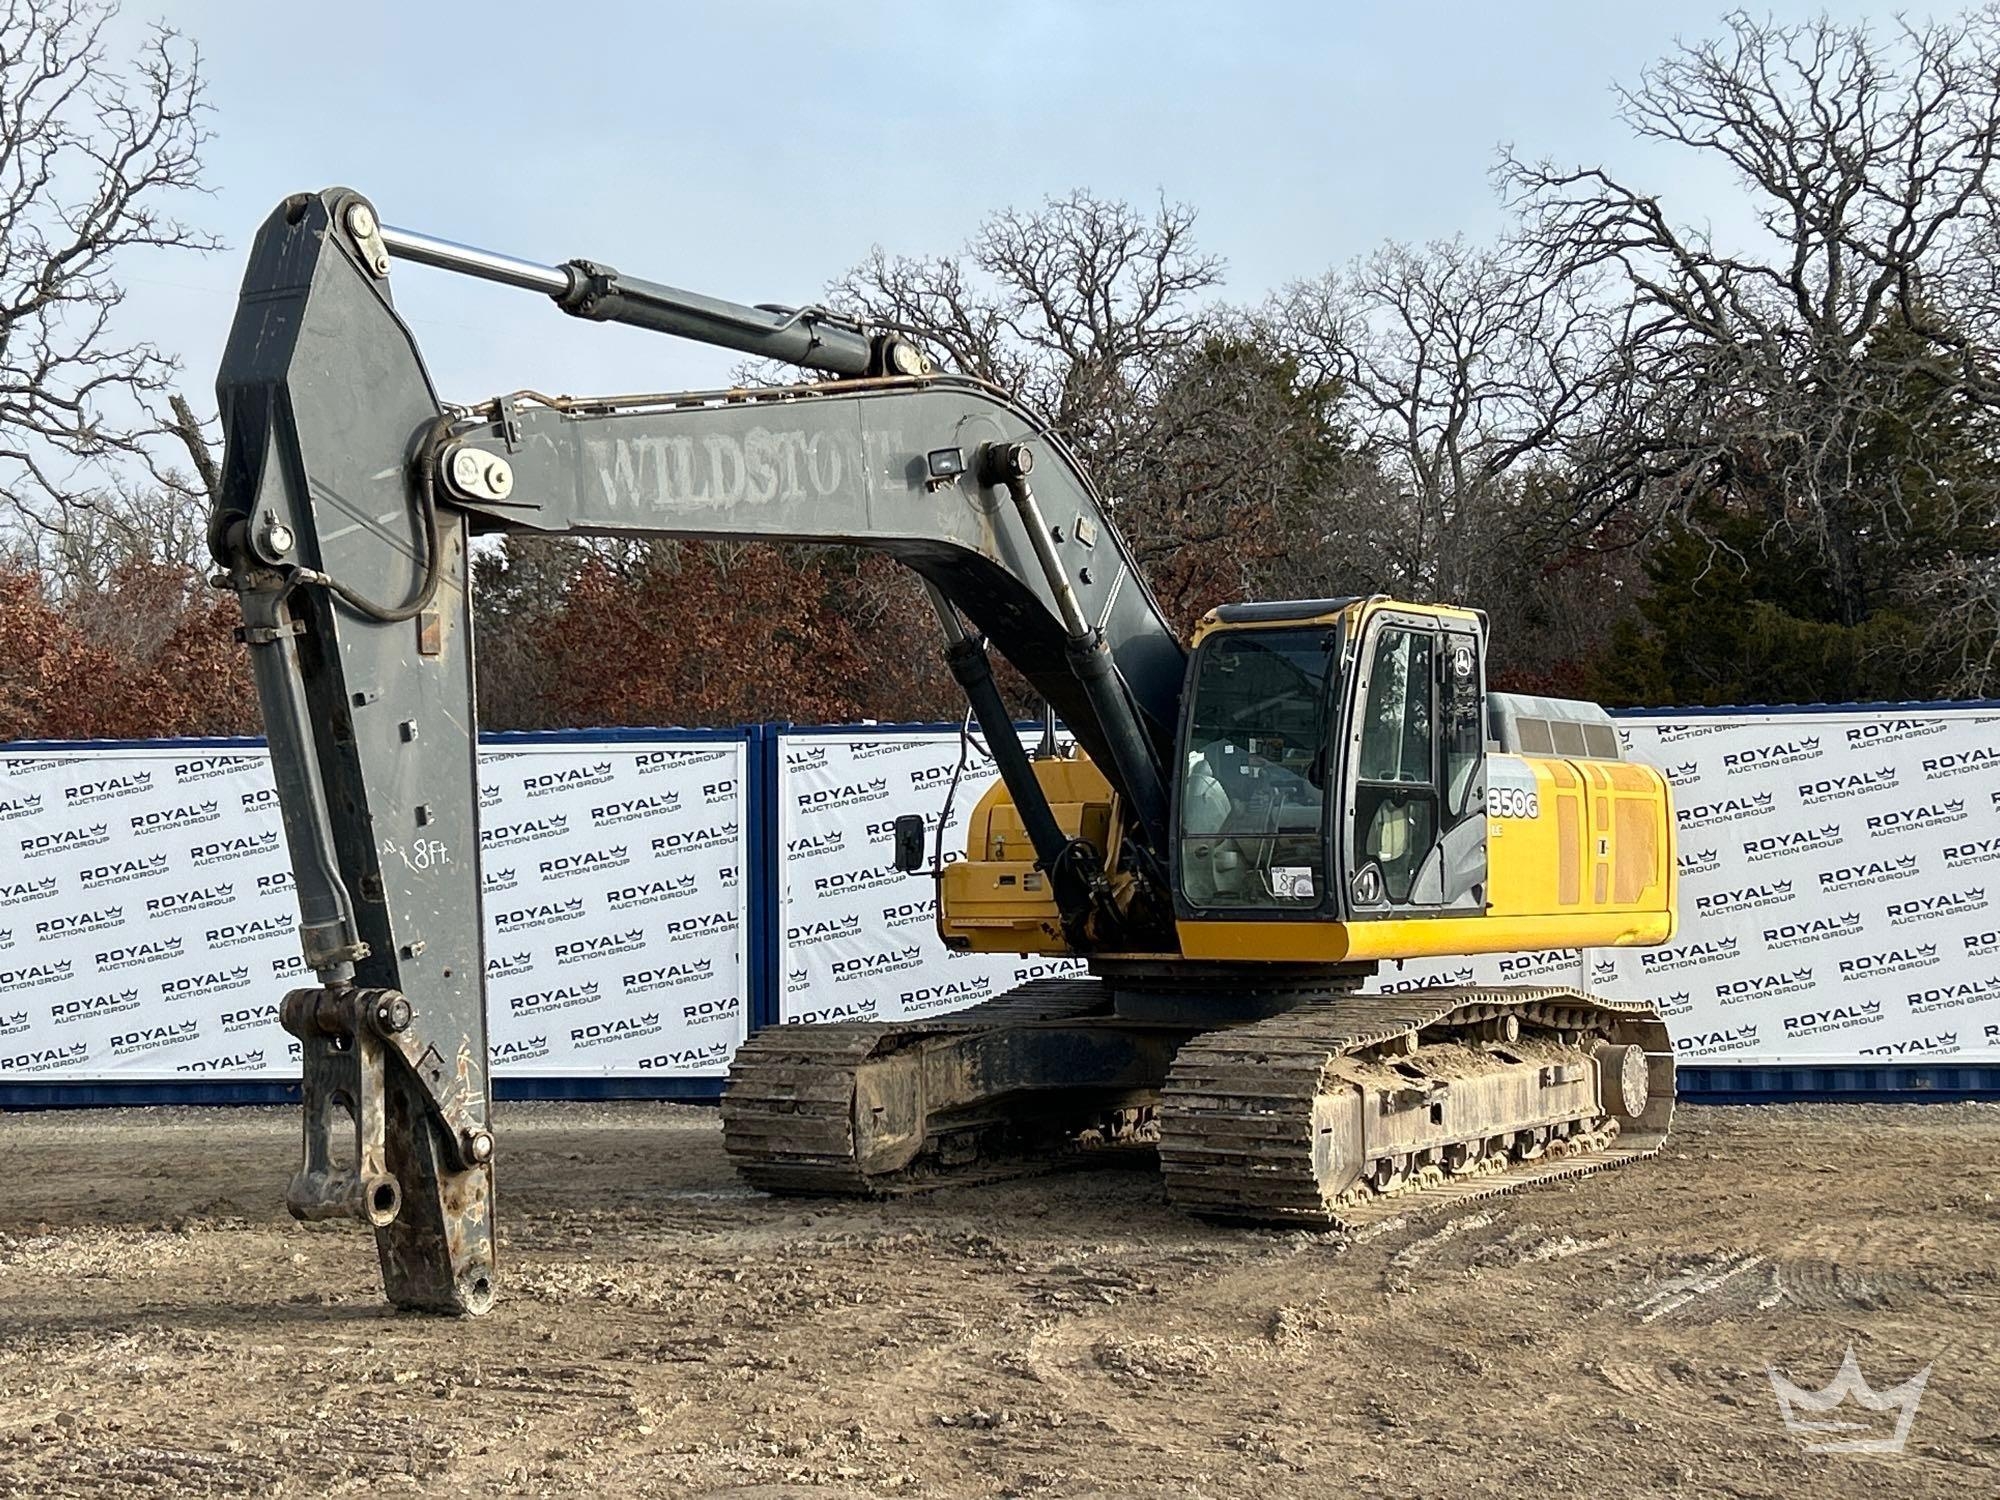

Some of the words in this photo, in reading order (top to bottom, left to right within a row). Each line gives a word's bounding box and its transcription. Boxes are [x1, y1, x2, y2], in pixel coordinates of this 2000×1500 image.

[1847, 722, 1924, 741] ROYAL
[1851, 734, 1902, 750] AUCTION
[1904, 725, 1946, 739] GROUP
[638, 760, 686, 774] AUCTION
[688, 752, 726, 765] GROUP
[1724, 742, 1801, 766] ROYAL
[1728, 759, 1779, 775] AUCTION
[1781, 750, 1823, 764] GROUP
[178, 769, 225, 784] AUCTION
[226, 761, 264, 774] GROUP
[790, 760, 828, 773] GROUP
[1927, 764, 1979, 780] AUCTION
[65, 777, 134, 799] ROYAL
[524, 768, 594, 790] ROYAL
[526, 783, 574, 798] AUCTION
[576, 775, 614, 788] GROUP
[1799, 773, 1877, 796] ROYAL
[68, 792, 114, 807] AUCTION
[116, 784, 154, 797] GROUP
[798, 784, 868, 806] ROYAL
[801, 800, 849, 814] AUCTION
[851, 791, 889, 804] GROUP
[1487, 787, 1538, 819] 350G
[1803, 789, 1855, 805] AUCTION
[1857, 780, 1899, 794] GROUP
[131, 806, 200, 828] ROYAL
[591, 797, 661, 819] ROYAL
[594, 812, 641, 827] AUCTION
[643, 804, 681, 817] GROUP
[1676, 798, 1754, 821] ROYAL
[1680, 814, 1732, 830] AUCTION
[1734, 805, 1776, 819] GROUP
[1867, 805, 1945, 828] ROYAL
[134, 821, 181, 836] AUCTION
[182, 813, 220, 826] GROUP
[481, 820, 550, 842] ROYAL
[1871, 821, 1923, 837] AUCTION
[1925, 812, 1967, 826] GROUP
[21, 829, 90, 851] ROYAL
[24, 844, 70, 859] AUCTION
[72, 836, 110, 849] GROUP
[191, 837, 260, 859] ROYAL
[482, 835, 530, 850] AUCTION
[532, 827, 570, 840] GROUP
[652, 828, 722, 850] ROYAL
[1744, 830, 1821, 853] ROYAL
[1748, 846, 1799, 862] AUCTION
[1801, 837, 1843, 851] GROUP
[194, 852, 240, 867] AUCTION
[242, 844, 280, 857] GROUP
[654, 843, 702, 858] AUCTION
[80, 860, 149, 882] ROYAL
[539, 851, 610, 873] ROYAL
[542, 866, 590, 881] AUCTION
[592, 858, 630, 871] GROUP
[1678, 862, 1720, 876] GROUP
[1819, 861, 1897, 884] ROYAL
[83, 875, 130, 890] AUCTION
[131, 867, 169, 880] GROUP
[815, 868, 885, 890] ROYAL
[818, 884, 866, 898] AUCTION
[868, 875, 906, 888] GROUP
[1823, 877, 1875, 893] AUCTION
[1877, 868, 1919, 882] GROUP
[21, 889, 59, 902] GROUP
[147, 889, 216, 911] ROYAL
[607, 880, 678, 902] ROYAL
[610, 896, 658, 910] AUCTION
[660, 888, 698, 901] GROUP
[1696, 886, 1774, 909] ROYAL
[150, 904, 196, 919] AUCTION
[198, 896, 236, 909] GROUP
[495, 903, 565, 925] ROYAL
[1700, 902, 1752, 918] AUCTION
[1754, 893, 1796, 907] GROUP
[1888, 893, 1965, 917] ROYAL
[1892, 910, 1943, 926] AUCTION
[1945, 901, 1987, 915] GROUP
[36, 912, 105, 934] ROYAL
[39, 927, 86, 942] AUCTION
[87, 919, 125, 932] GROUP
[206, 920, 275, 942] ROYAL
[498, 919, 545, 933] AUCTION
[547, 911, 585, 924] GROUP
[886, 913, 934, 928] AUCTION
[1764, 918, 1841, 941] ROYAL
[209, 935, 256, 950] AUCTION
[257, 927, 295, 940] GROUP
[555, 934, 626, 956] ROYAL
[671, 927, 718, 942] AUCTION
[823, 928, 861, 941] GROUP
[1768, 934, 1819, 950] AUCTION
[1821, 925, 1863, 939] GROUP
[96, 942, 164, 964] ROYAL
[98, 957, 145, 972] AUCTION
[147, 949, 184, 962] GROUP
[558, 950, 606, 964] AUCTION
[608, 942, 646, 955] GROUP
[832, 952, 902, 974] ROYAL
[1499, 949, 1574, 973] ROYAL
[1641, 942, 1718, 966] ROYAL
[1645, 959, 1696, 975] AUCTION
[1698, 950, 1740, 964] GROUP
[1840, 949, 1917, 973] ROYAL
[36, 972, 74, 985] GROUP
[623, 964, 693, 986] ROYAL
[835, 968, 883, 982] AUCTION
[885, 959, 923, 972] GROUP
[1013, 958, 1084, 981] ROYAL
[1502, 966, 1554, 981] AUCTION
[1844, 966, 1895, 982] AUCTION
[1897, 957, 1939, 971] GROUP
[162, 972, 230, 994] ROYAL
[164, 987, 212, 1002] AUCTION
[213, 979, 250, 992] GROUP
[626, 980, 673, 994] AUCTION
[675, 972, 713, 985] GROUP
[901, 982, 971, 1004] ROYAL
[1716, 973, 1794, 997] ROYAL
[1720, 990, 1772, 1006] AUCTION
[1774, 981, 1816, 995] GROUP
[1908, 982, 1986, 1005] ROYAL
[52, 995, 120, 1017] ROYAL
[510, 987, 581, 1009] ROYAL
[513, 1003, 561, 1017] AUCTION
[563, 995, 601, 1008] GROUP
[904, 998, 952, 1012] AUCTION
[954, 989, 992, 1002] GROUP
[1912, 998, 1964, 1014] AUCTION
[54, 1010, 101, 1025] AUCTION
[103, 1002, 140, 1015] GROUP
[686, 1011, 734, 1026] AUCTION
[1784, 1006, 1861, 1030] ROYAL
[224, 1018, 270, 1033] AUCTION
[571, 1018, 641, 1040] ROYAL
[1788, 1023, 1839, 1039] AUCTION
[1841, 1014, 1883, 1028] GROUP
[111, 1026, 179, 1048] ROYAL
[113, 1041, 160, 1056] AUCTION
[162, 1033, 199, 1046] GROUP
[574, 1034, 621, 1048] AUCTION
[623, 1026, 661, 1039] GROUP
[1718, 1038, 1760, 1052] GROUP
[1, 1048, 70, 1070] ROYAL
[52, 1055, 90, 1068] GROUP
[639, 1048, 709, 1069] ROYAL
